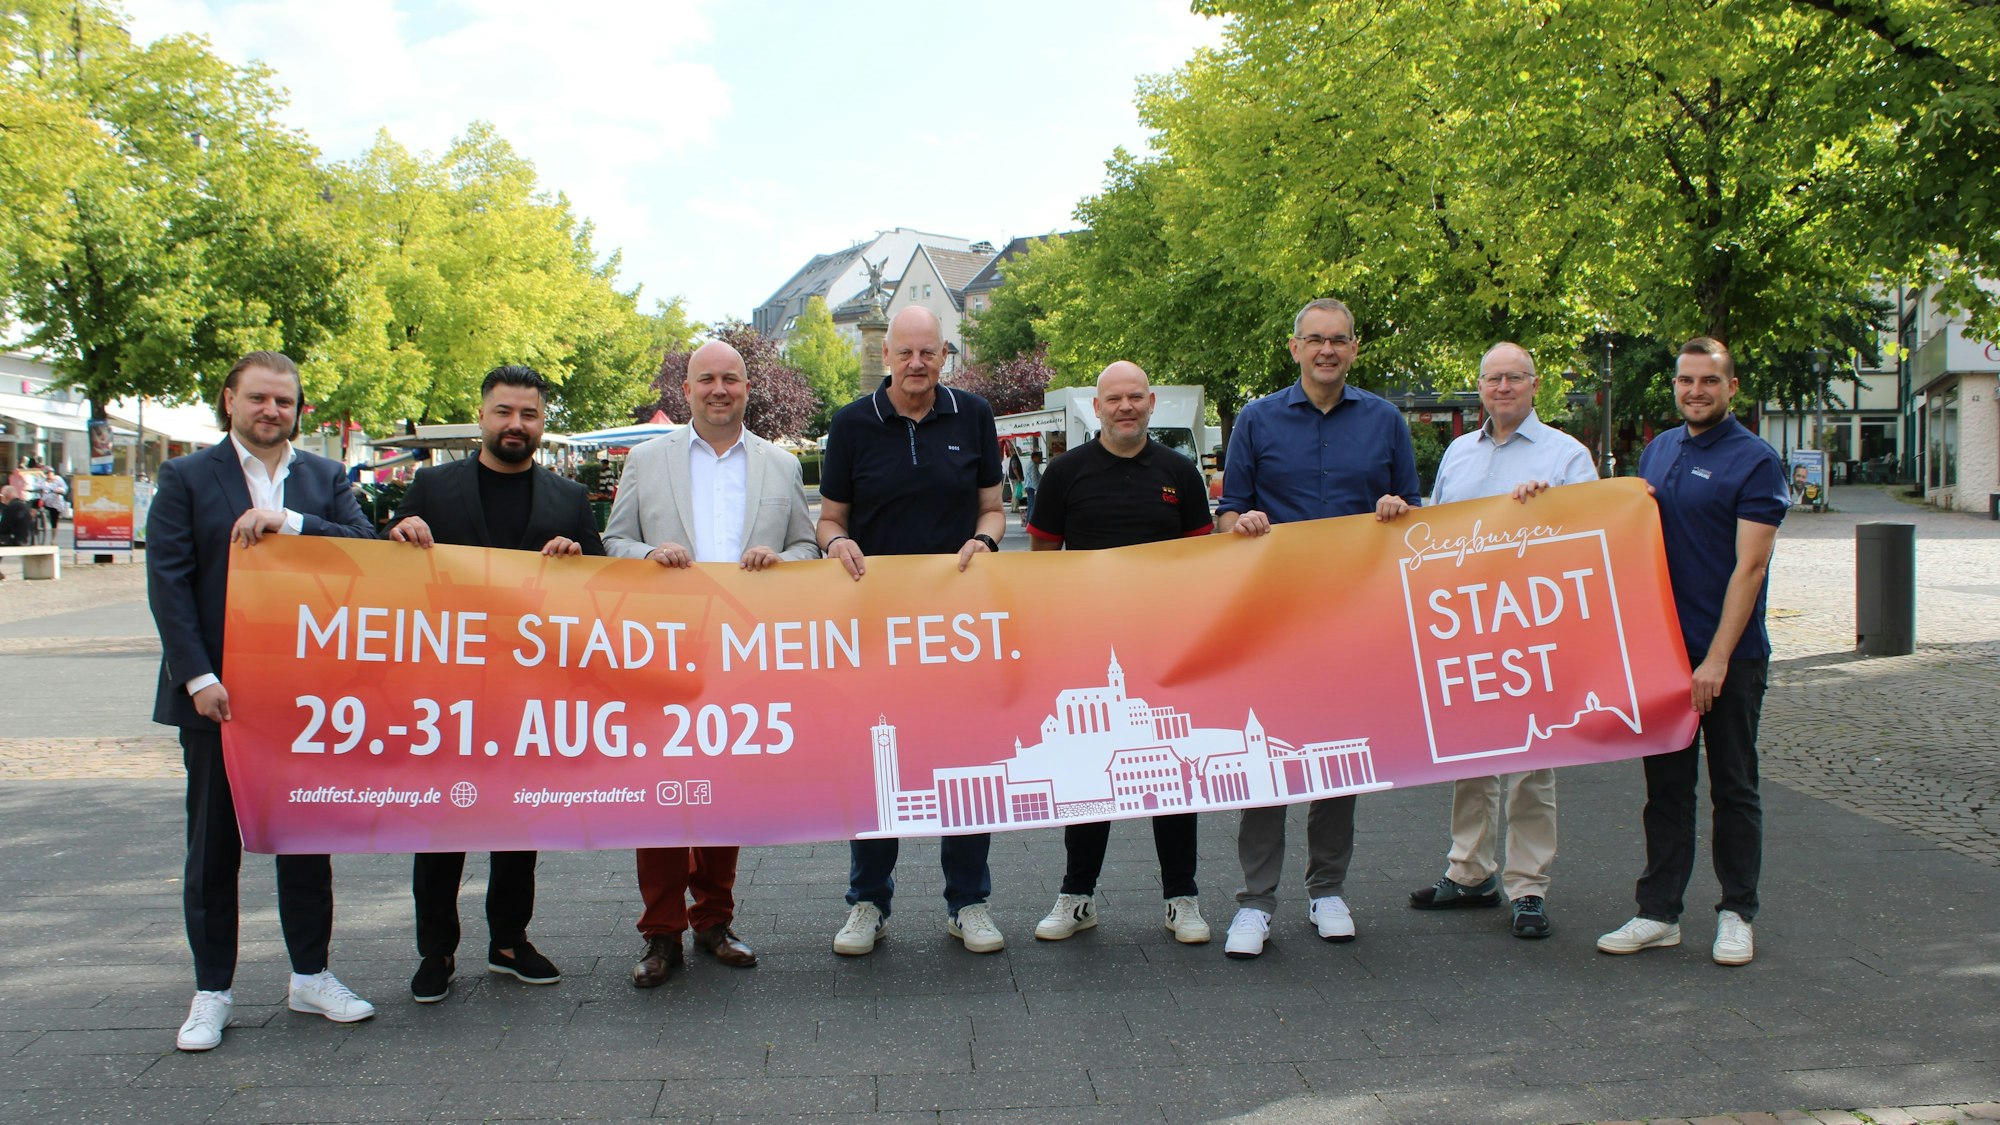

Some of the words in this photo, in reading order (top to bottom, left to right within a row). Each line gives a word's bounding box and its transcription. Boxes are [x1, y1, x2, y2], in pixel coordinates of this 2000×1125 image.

[1404, 519, 1563, 570] Siegburger
[1428, 568, 1594, 640] STADT
[296, 604, 488, 665] MEINE
[512, 613, 696, 673] STADT.
[721, 618, 861, 672] MEIN
[886, 611, 1021, 666] FEST.
[1436, 642, 1558, 707] FEST
[291, 694, 499, 757] 29.-31.
[513, 699, 647, 758] AUG.
[662, 701, 795, 757] 2025
[288, 786, 442, 808] stadtfest.siegburg.de
[512, 786, 647, 808] siegburgerstadtfest
